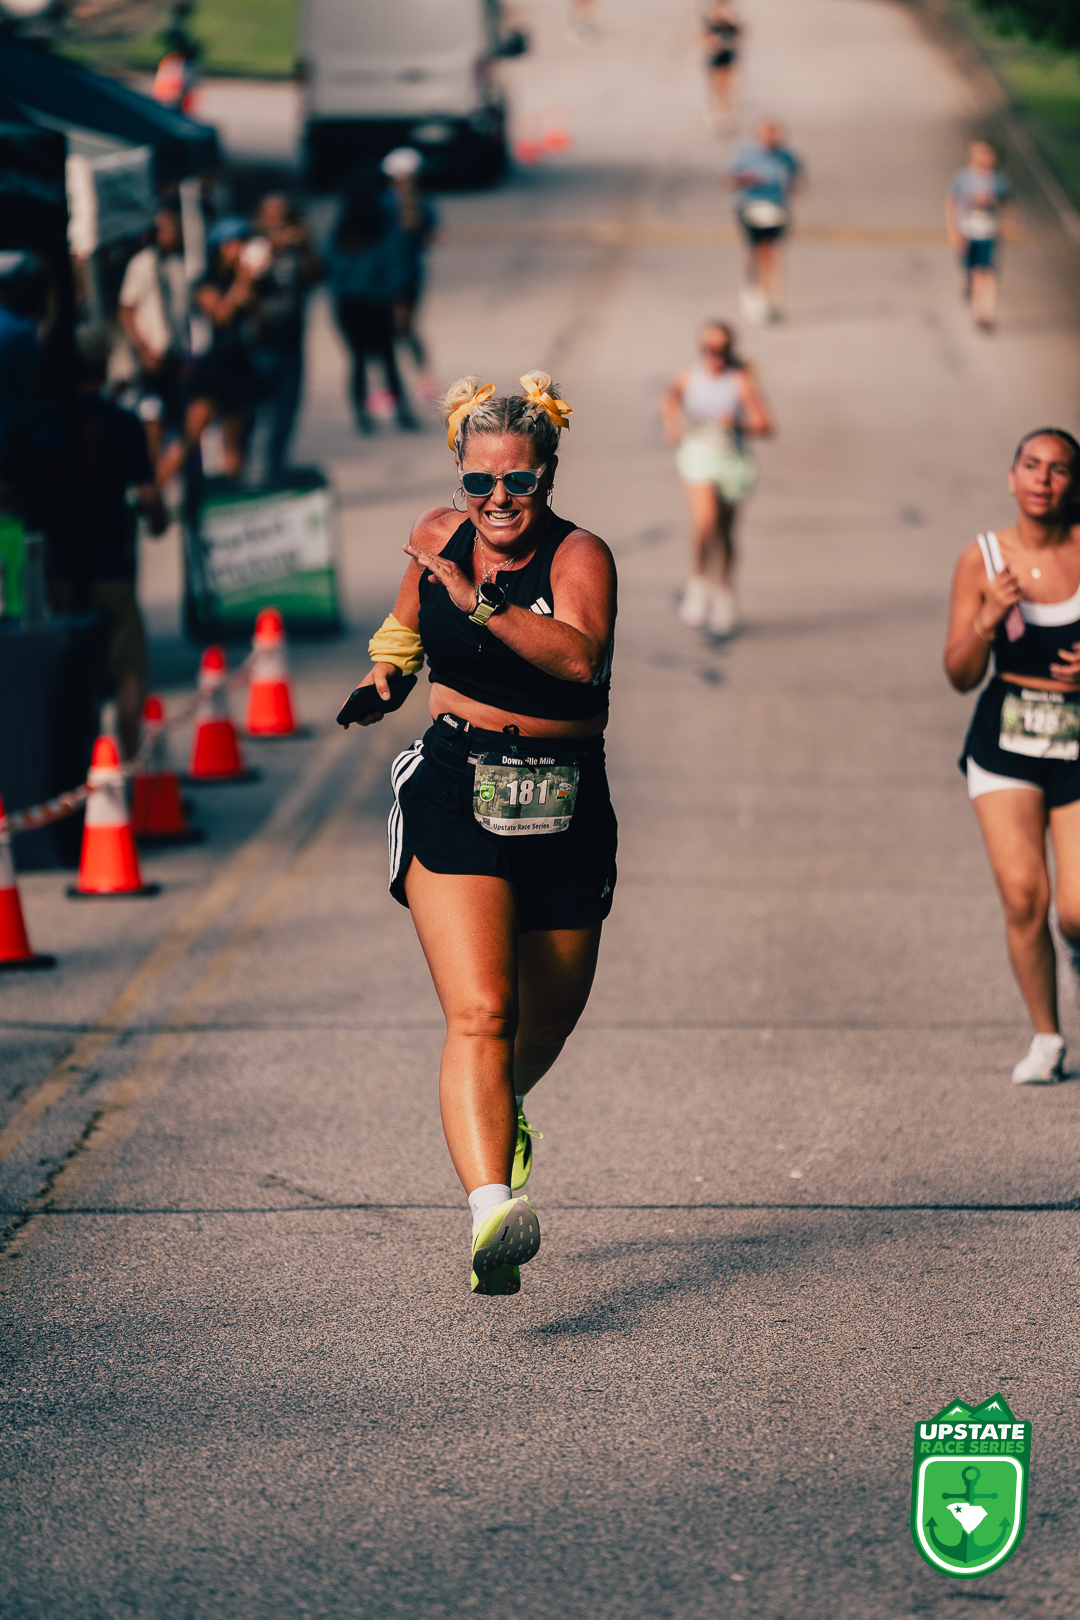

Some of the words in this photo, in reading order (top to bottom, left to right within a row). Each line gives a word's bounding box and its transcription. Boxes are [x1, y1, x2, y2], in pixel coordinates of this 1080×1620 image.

[502, 755, 538, 766] Downille
[539, 757, 555, 765] Mile
[506, 779, 548, 806] 181
[493, 823, 517, 831] Upstate
[531, 822, 550, 830] Series
